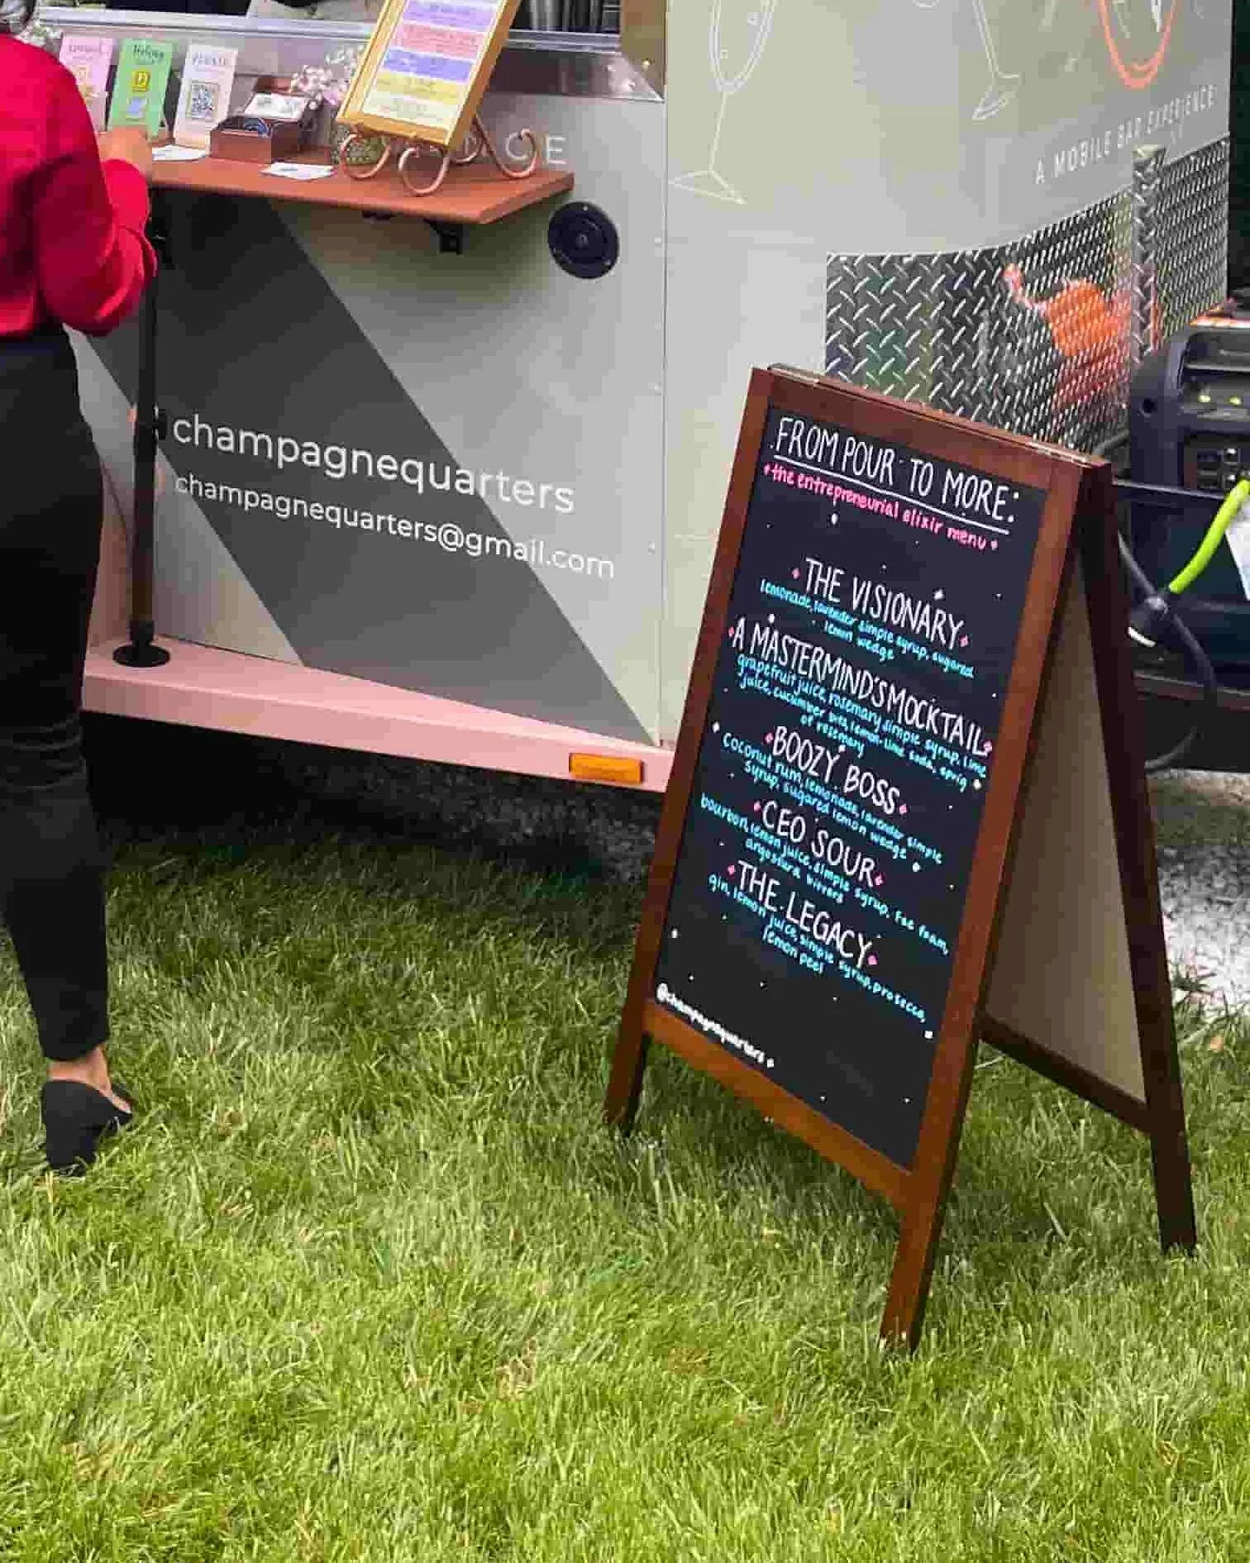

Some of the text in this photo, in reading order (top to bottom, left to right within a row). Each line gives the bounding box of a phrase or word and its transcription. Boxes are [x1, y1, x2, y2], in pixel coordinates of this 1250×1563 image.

[1035, 84, 1215, 185] A MOBILE BAR EXPERIENCE
[173, 413, 576, 514] champagnequarters
[771, 463, 987, 551] the entrepreneurial elixir menu
[775, 417, 1019, 523] FROM POUR TO MORE:
[175, 472, 615, 579] champagnequarters@gmail.com
[806, 557, 965, 650] THE VISIONARY
[824, 620, 854, 643] lemon
[732, 617, 988, 757] A MASTERMIND'S MOCKTAIL
[737, 653, 797, 687] grapefruit
[828, 692, 882, 734] rosemary
[772, 725, 900, 815] BOOZY BOSS
[762, 800, 874, 888] CEO SOUR
[737, 859, 873, 970] THE LEGACY
[798, 952, 825, 975] peel
